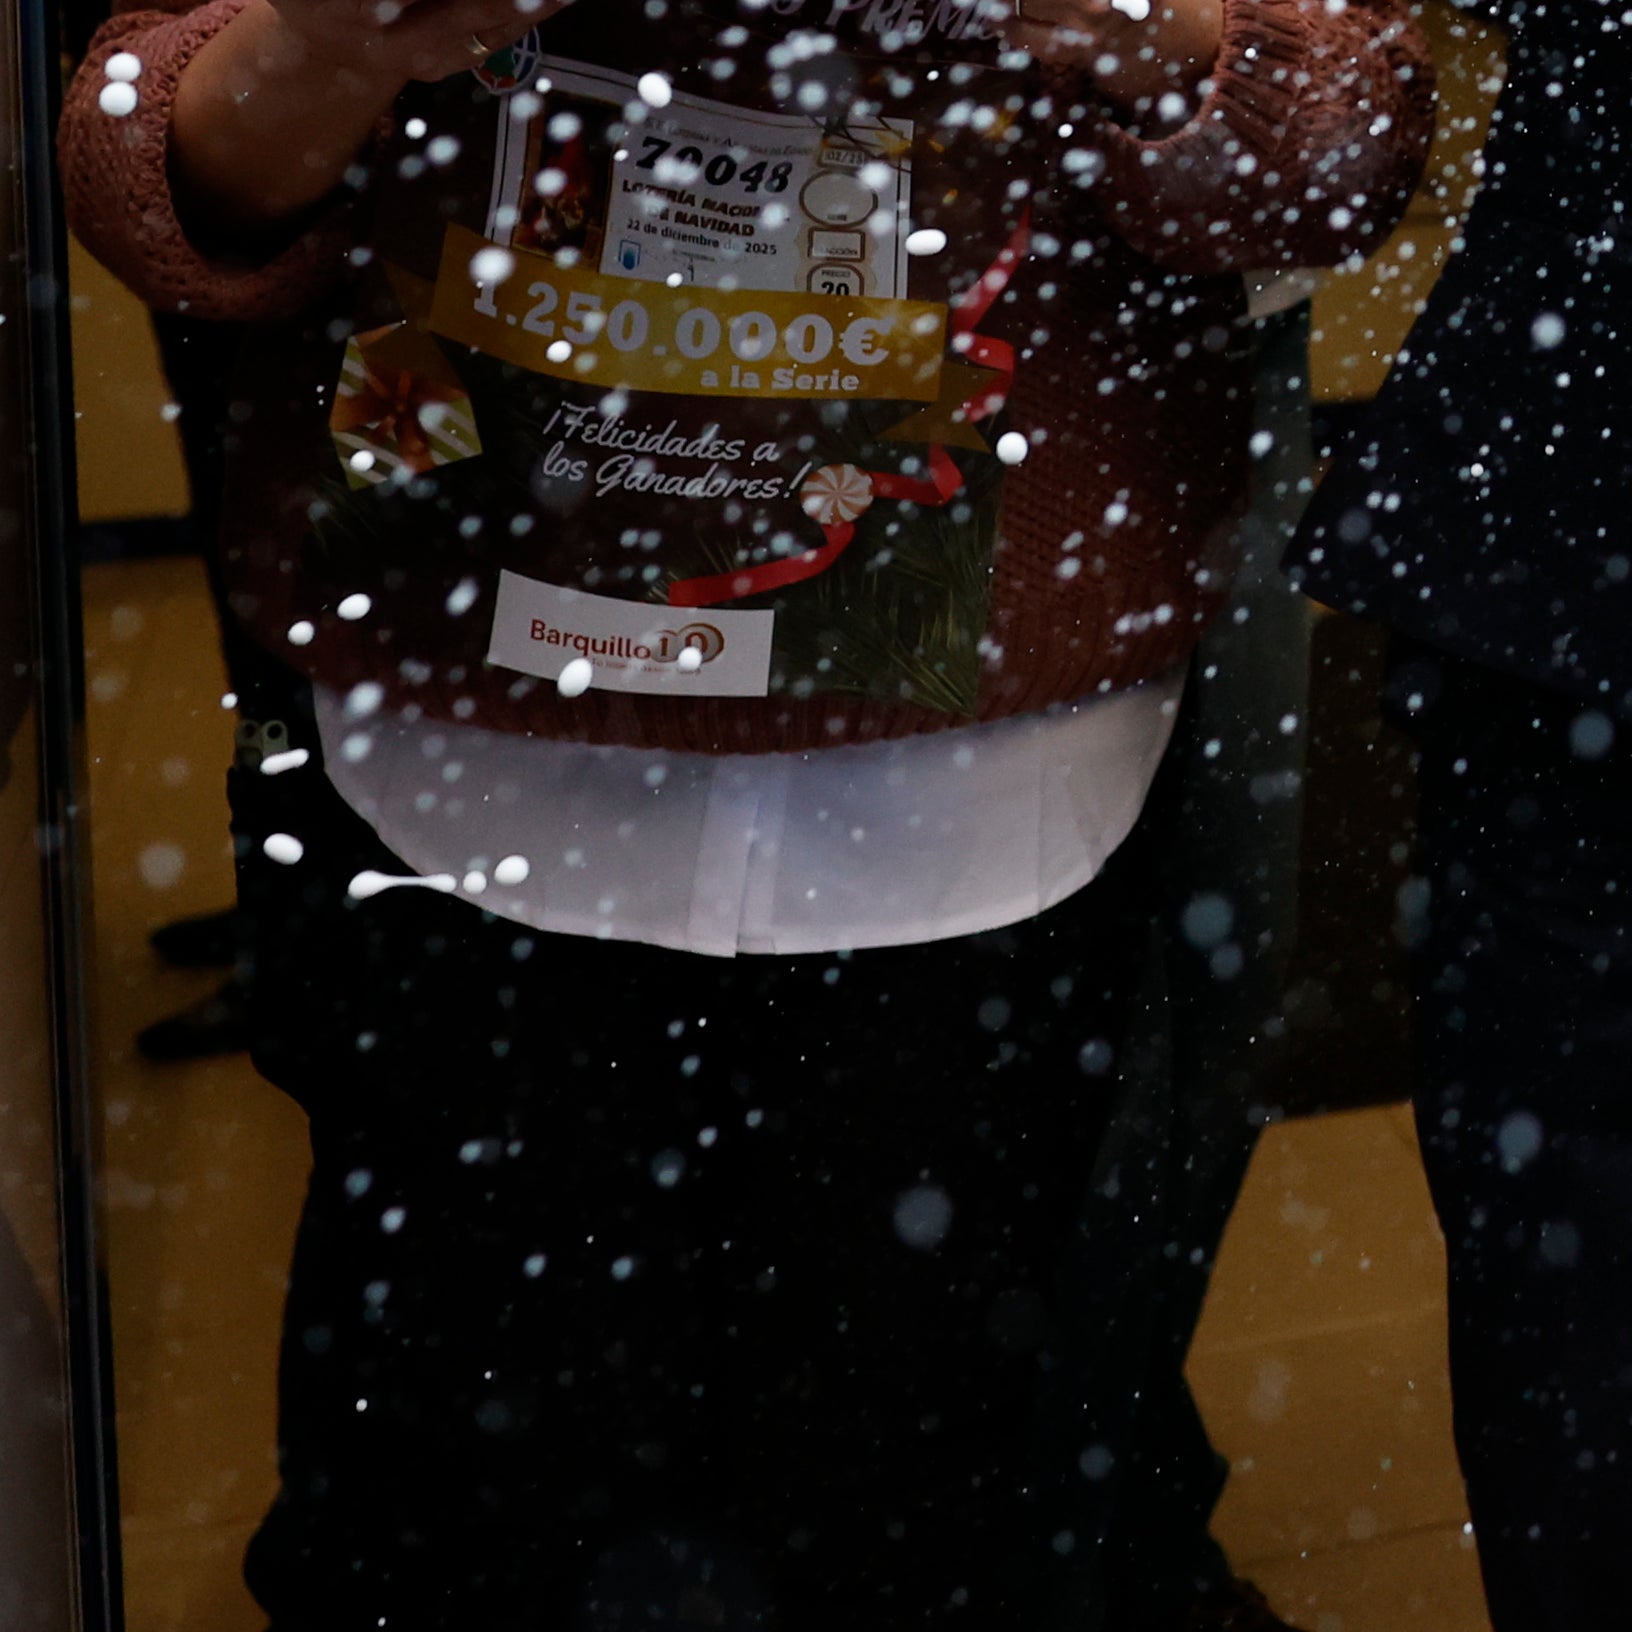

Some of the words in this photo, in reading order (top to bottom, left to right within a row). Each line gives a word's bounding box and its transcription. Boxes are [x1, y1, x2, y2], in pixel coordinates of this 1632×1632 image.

[626, 218, 640, 231] 22
[643, 222, 658, 236] de
[660, 224, 720, 248] diciembre
[744, 241, 778, 255] 2025
[674, 211, 756, 237] NAVIDAD
[820, 281, 850, 297] 20
[472, 279, 898, 366] 1.250.000€
[700, 370, 720, 388] a
[730, 365, 763, 390] la
[770, 366, 861, 392] Serie
[752, 439, 781, 463] a
[542, 440, 586, 482] los
[595, 454, 814, 498] Ganadores!
[530, 618, 652, 657] Barquillo
